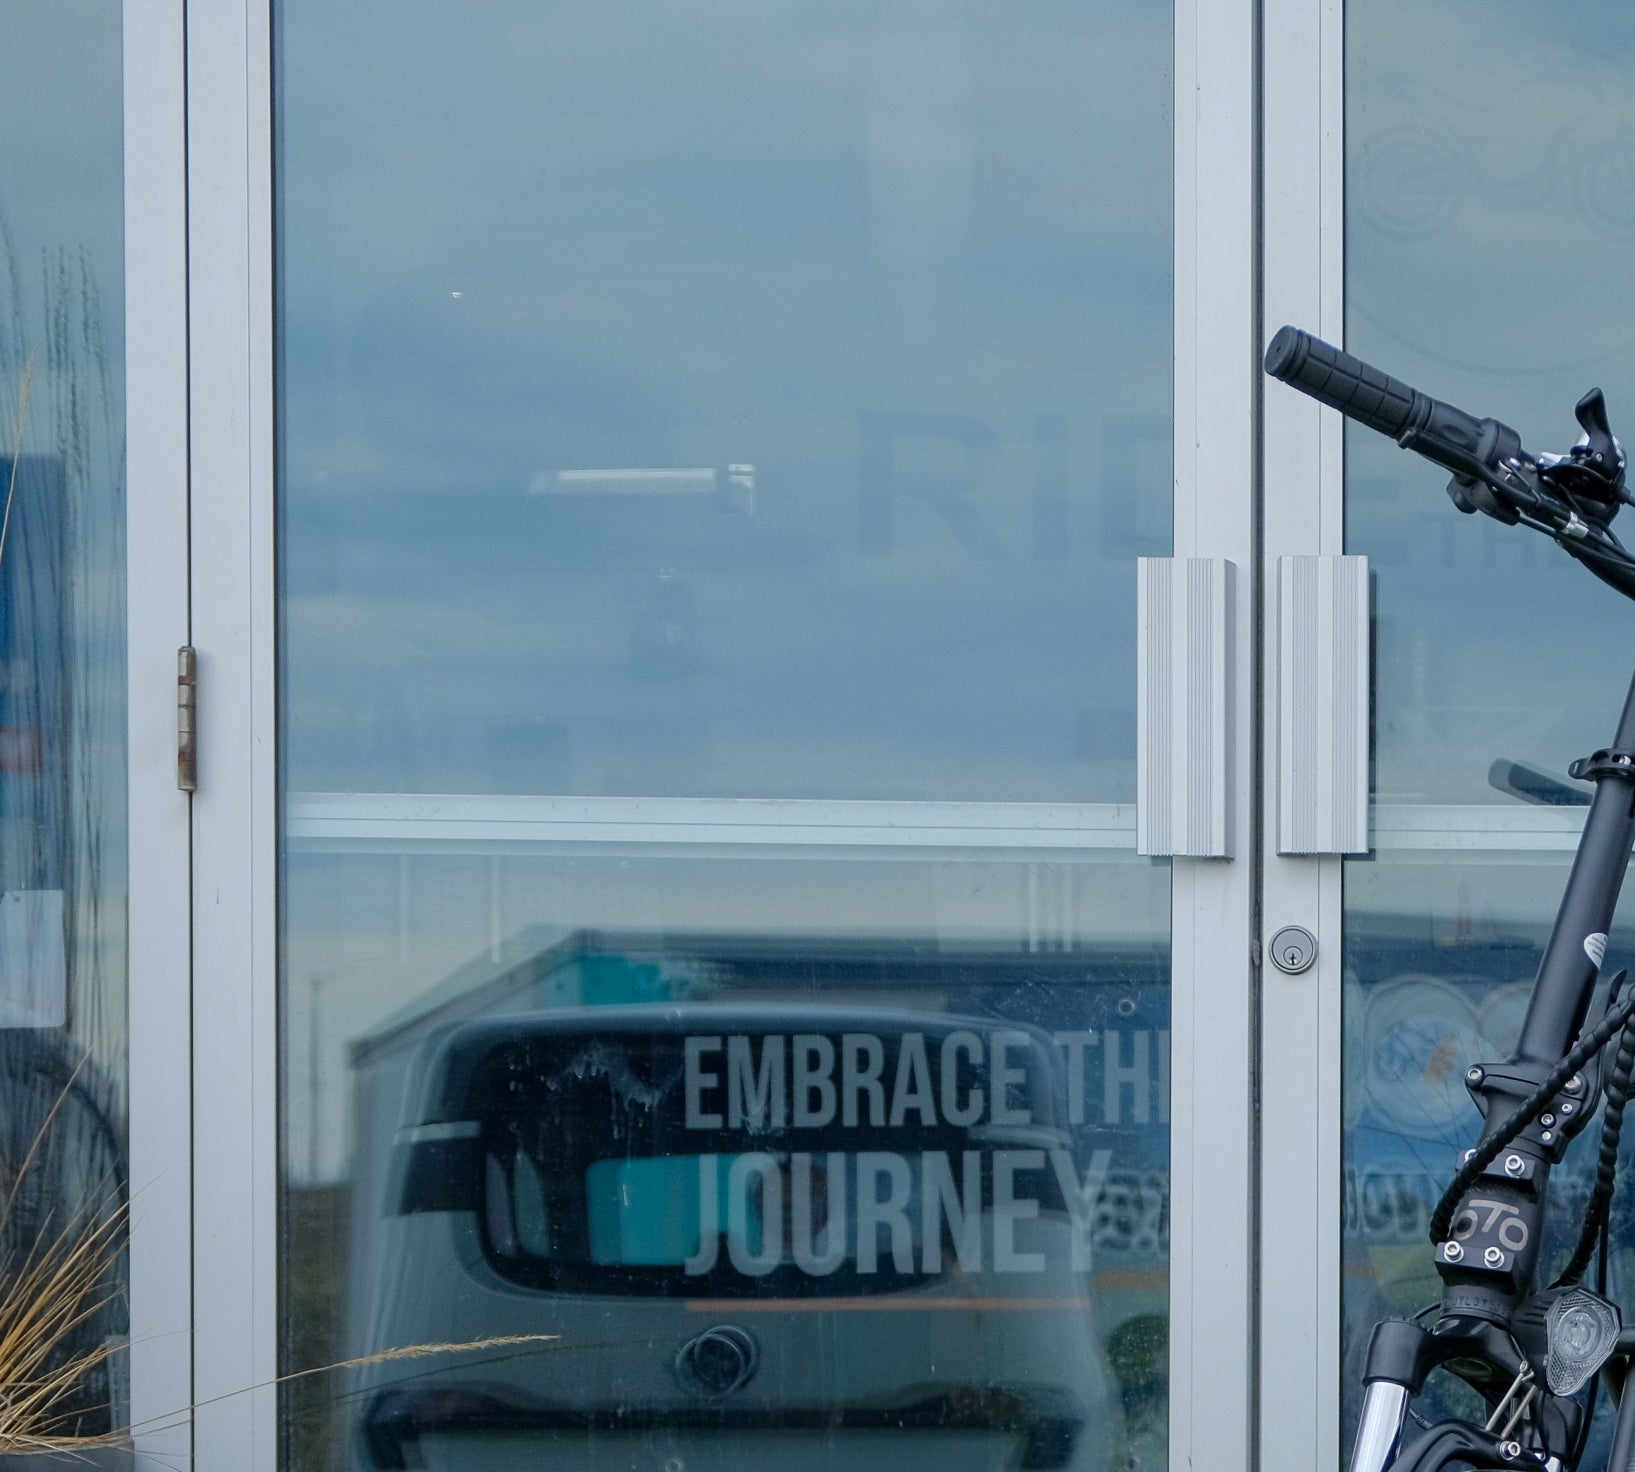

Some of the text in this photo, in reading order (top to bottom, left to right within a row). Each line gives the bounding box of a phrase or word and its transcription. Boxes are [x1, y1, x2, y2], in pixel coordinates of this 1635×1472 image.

[684, 1029, 1171, 1130] EMBRACE TH
[685, 1149, 1112, 1277] JOURNEY
